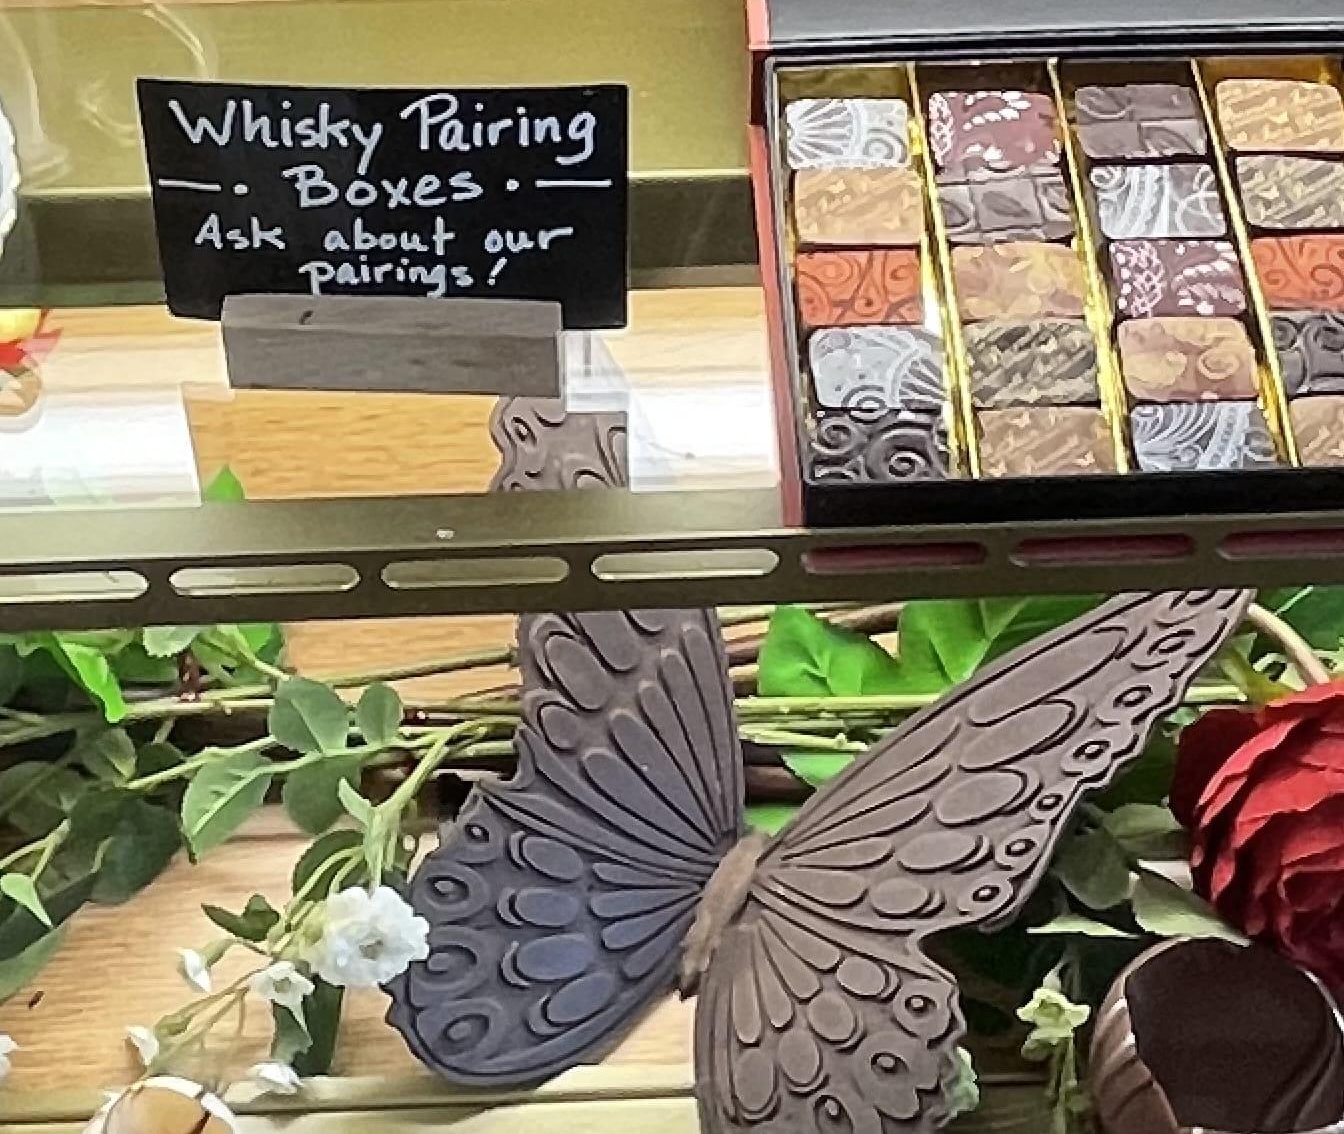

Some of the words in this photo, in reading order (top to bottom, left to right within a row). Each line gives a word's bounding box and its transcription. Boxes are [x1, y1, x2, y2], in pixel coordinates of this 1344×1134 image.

[168, 99, 383, 175] Whisky
[400, 93, 596, 166] Pairing
[282, 164, 484, 209] Boxes
[194, 213, 286, 250] Ask
[324, 216, 456, 256] about
[484, 226, 574, 254] our
